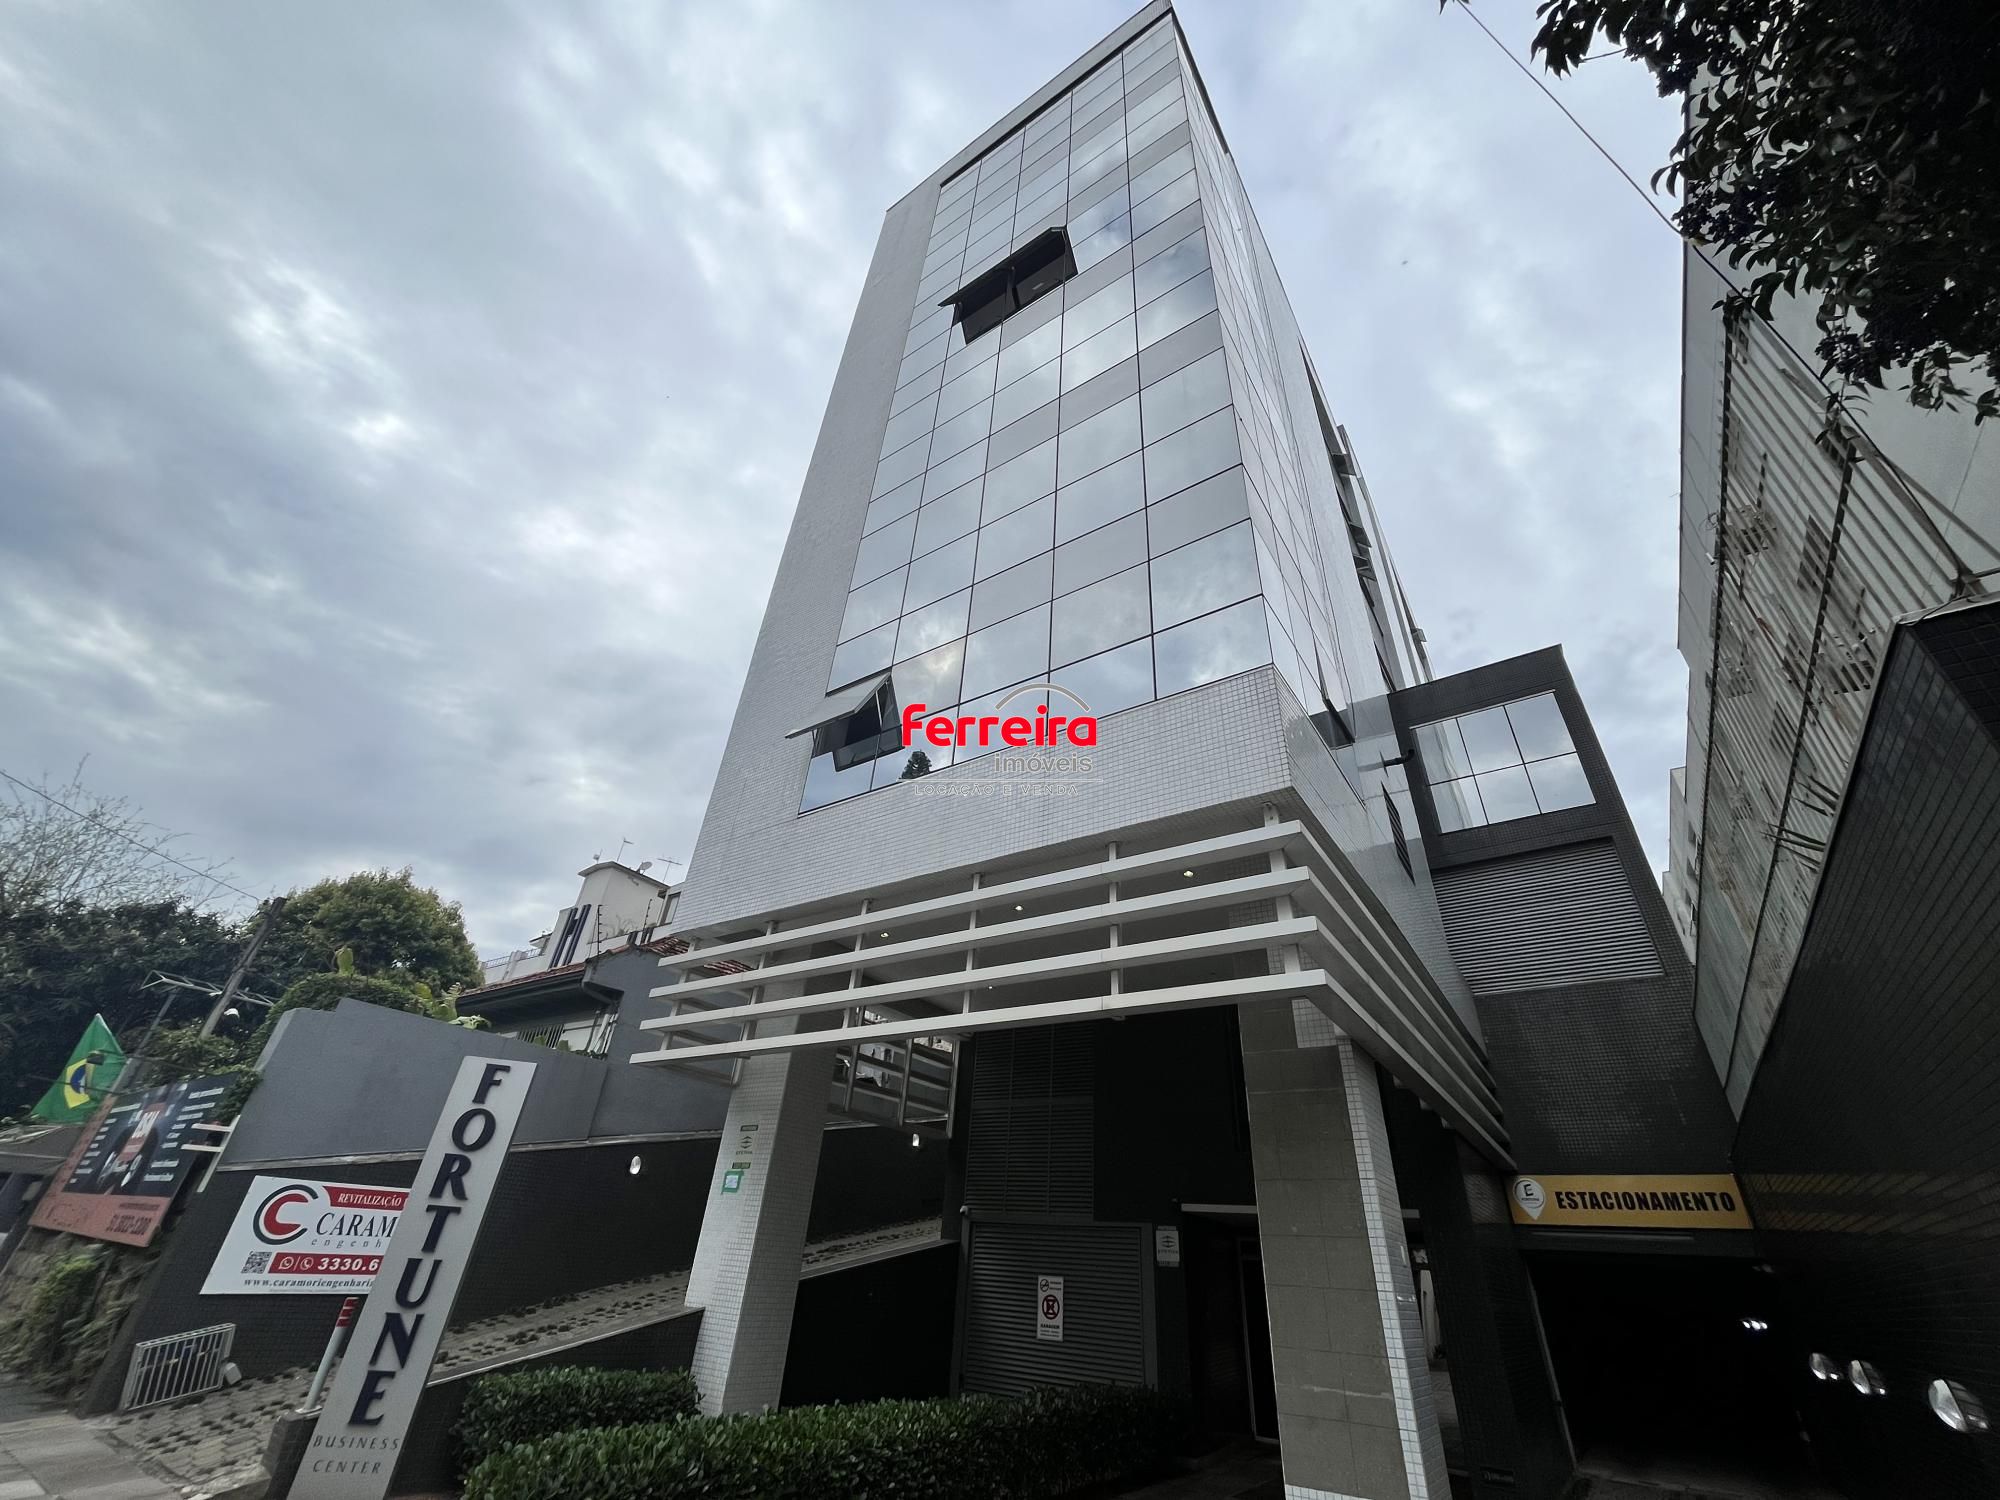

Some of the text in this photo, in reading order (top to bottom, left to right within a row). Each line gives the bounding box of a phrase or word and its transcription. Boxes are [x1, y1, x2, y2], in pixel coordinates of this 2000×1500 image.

[1522, 1183, 1534, 1197] E
[1554, 1191, 1737, 1212] ESTACIONAMENTO
[316, 1212, 399, 1238] CARAM
[311, 1238, 382, 1249] engenh
[346, 1062, 511, 1428] FORTUNE
[317, 1258, 380, 1272] 3330.6
[243, 1278, 374, 1290] www.caramoriengenhari
[313, 1434, 400, 1450] BUSINESS
[312, 1459, 382, 1475] CENTER
